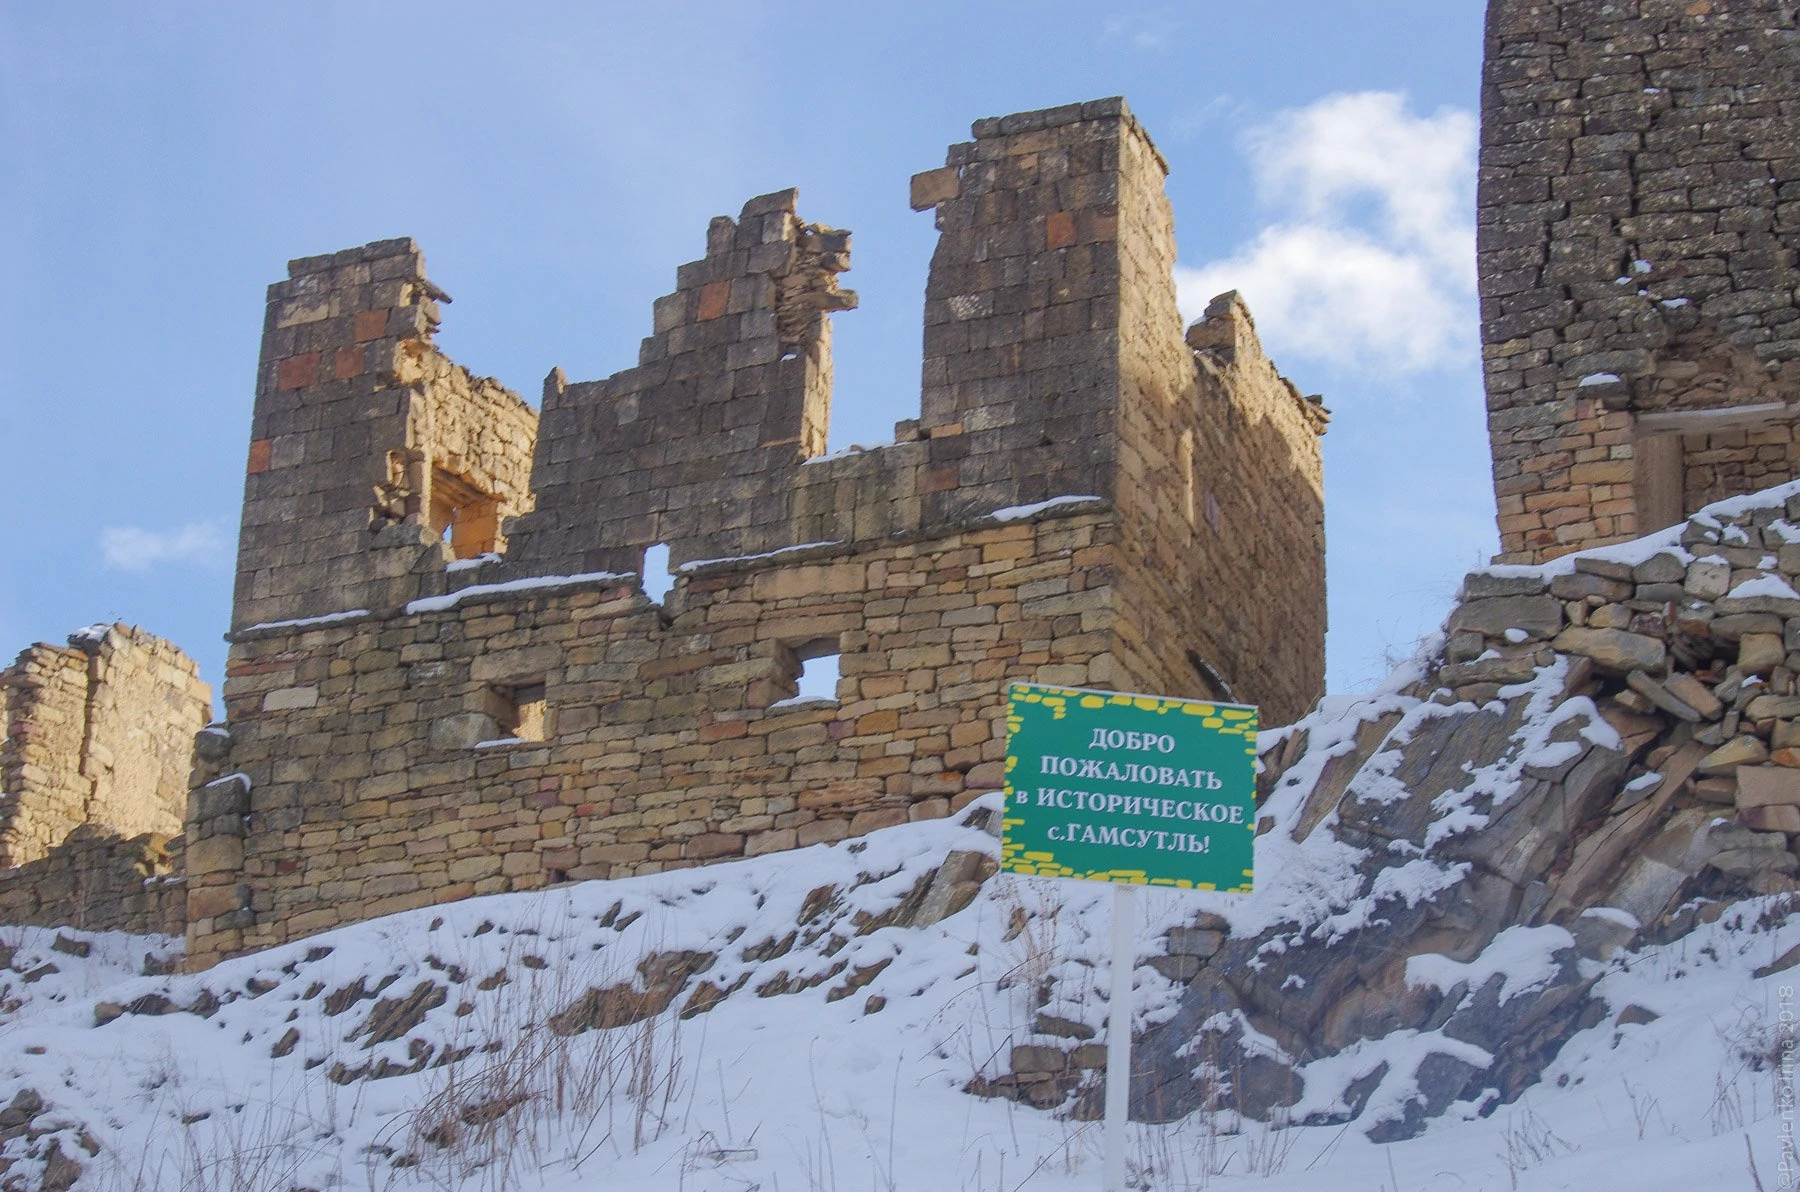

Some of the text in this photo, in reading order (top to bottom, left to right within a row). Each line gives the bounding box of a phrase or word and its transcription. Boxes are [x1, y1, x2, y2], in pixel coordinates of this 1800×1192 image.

[1088, 728, 1176, 754] ДОБРО
[1040, 755, 1223, 790] ПОЖАЛОВАТЬ
[1015, 788, 1245, 825] в ИСТОРИЧЕСКОЕ
[1047, 823, 1210, 854] с.ГАМСУТЛЬ!
